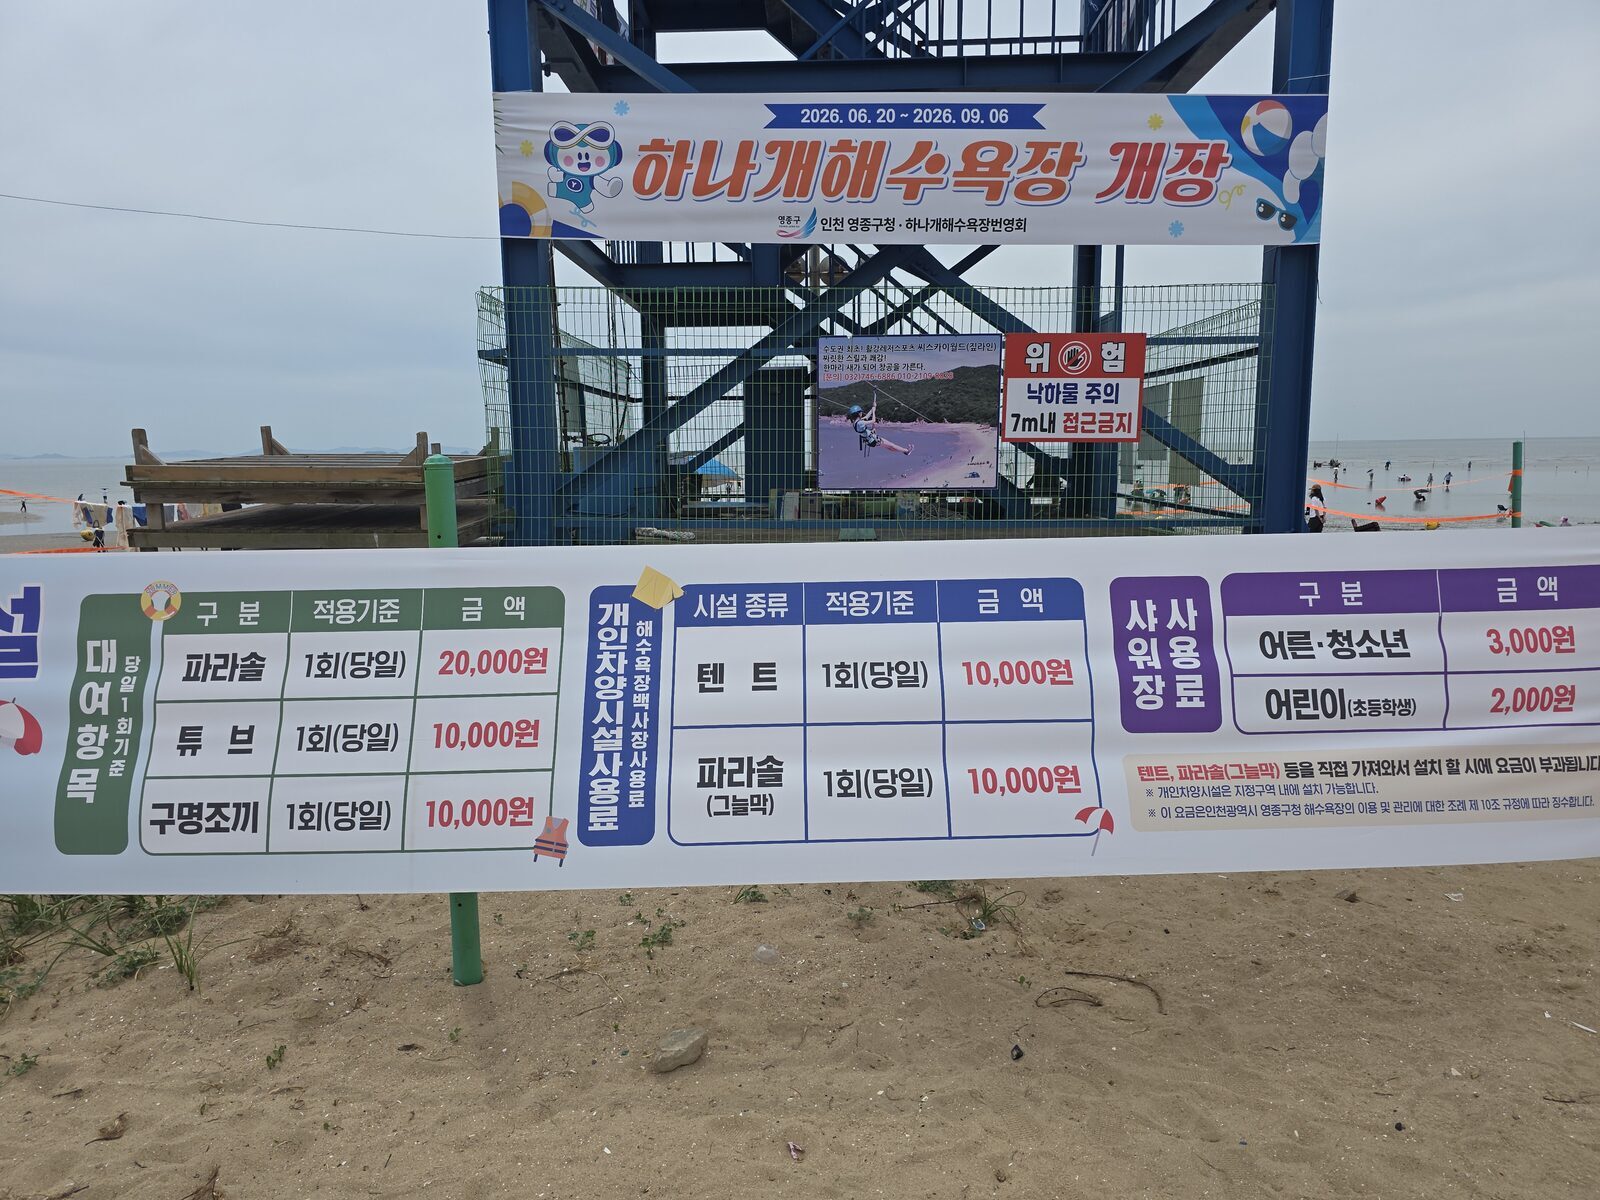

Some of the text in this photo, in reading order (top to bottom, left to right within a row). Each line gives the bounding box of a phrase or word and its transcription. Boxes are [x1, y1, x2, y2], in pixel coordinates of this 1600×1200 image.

[801, 108, 843, 124] 2026.
[848, 108, 871, 124] 06.
[876, 108, 895, 124] 20
[913, 108, 956, 124] 2026.
[961, 108, 984, 124] 09.
[989, 108, 1009, 124] 06
[631, 138, 1232, 205] 하나개해수욕장 개장
[778, 215, 801, 225] 영종구
[820, 217, 844, 232] 인천
[847, 217, 895, 232] 영종구청
[905, 217, 1027, 233] 하나개해수욕장번영회
[823, 345, 844, 353] 수도권
[846, 354, 868, 362] 스릴과
[823, 363, 844, 372] 한마리
[847, 363, 860, 371] 새가
[863, 363, 877, 371] 되어
[1027, 382, 1120, 405] 낙하물 주의
[1011, 411, 1132, 434] 7m내 접근금지
[313, 598, 400, 624] 적용기준
[694, 593, 738, 619] 시설
[744, 592, 789, 618] 종류
[826, 590, 915, 617] 적용기준
[1259, 625, 1576, 661] 어른·청소년 3,000원
[182, 647, 549, 683] 파라솔 1회(당일) 20,000원
[822, 660, 928, 689] 1회(당일)
[961, 658, 1074, 688] 10,000원
[1489, 684, 1576, 715] 2,000원
[66, 639, 118, 804] 대여항목
[586, 602, 630, 832] 개인차양시설사용료
[296, 723, 399, 753] 1회(당일)
[433, 719, 541, 750] 10,000원
[696, 755, 1082, 799] 파라솔 1회(당일) 10,000원
[1137, 765, 1175, 782] 텐트,
[1177, 762, 1281, 781] 파라솔(그늘막)
[1283, 761, 1315, 779] 등을
[1317, 760, 1349, 777] 직접
[1352, 758, 1411, 777] 가져와서
[1413, 758, 1443, 776] 설치
[1446, 758, 1461, 775] 할
[1464, 757, 1493, 775] 시에
[1496, 756, 1537, 774] 요금이
[1158, 784, 1232, 799] 개인차양시설은
[1235, 783, 1276, 797] 지정구역
[1278, 783, 1300, 796] 내에
[1302, 783, 1323, 796] 설치
[1326, 782, 1379, 795] 가능합니다.
[149, 796, 535, 835] 구명조끼 1회(당일) 10,000원
[706, 793, 775, 818] (그늘막)
[1161, 806, 1172, 819] 이
[1260, 803, 1301, 817] 영종구청
[1304, 802, 1354, 816] 해수욕장의
[1358, 802, 1377, 814] 이용
[1381, 801, 1390, 814] 및
[1393, 801, 1423, 813] 관리에
[1425, 800, 1445, 812] 대한
[1448, 799, 1467, 812] 조례
[1481, 799, 1501, 811] 10조
[1502, 798, 1530, 810] 규정에
[1532, 797, 1550, 809] 따라
